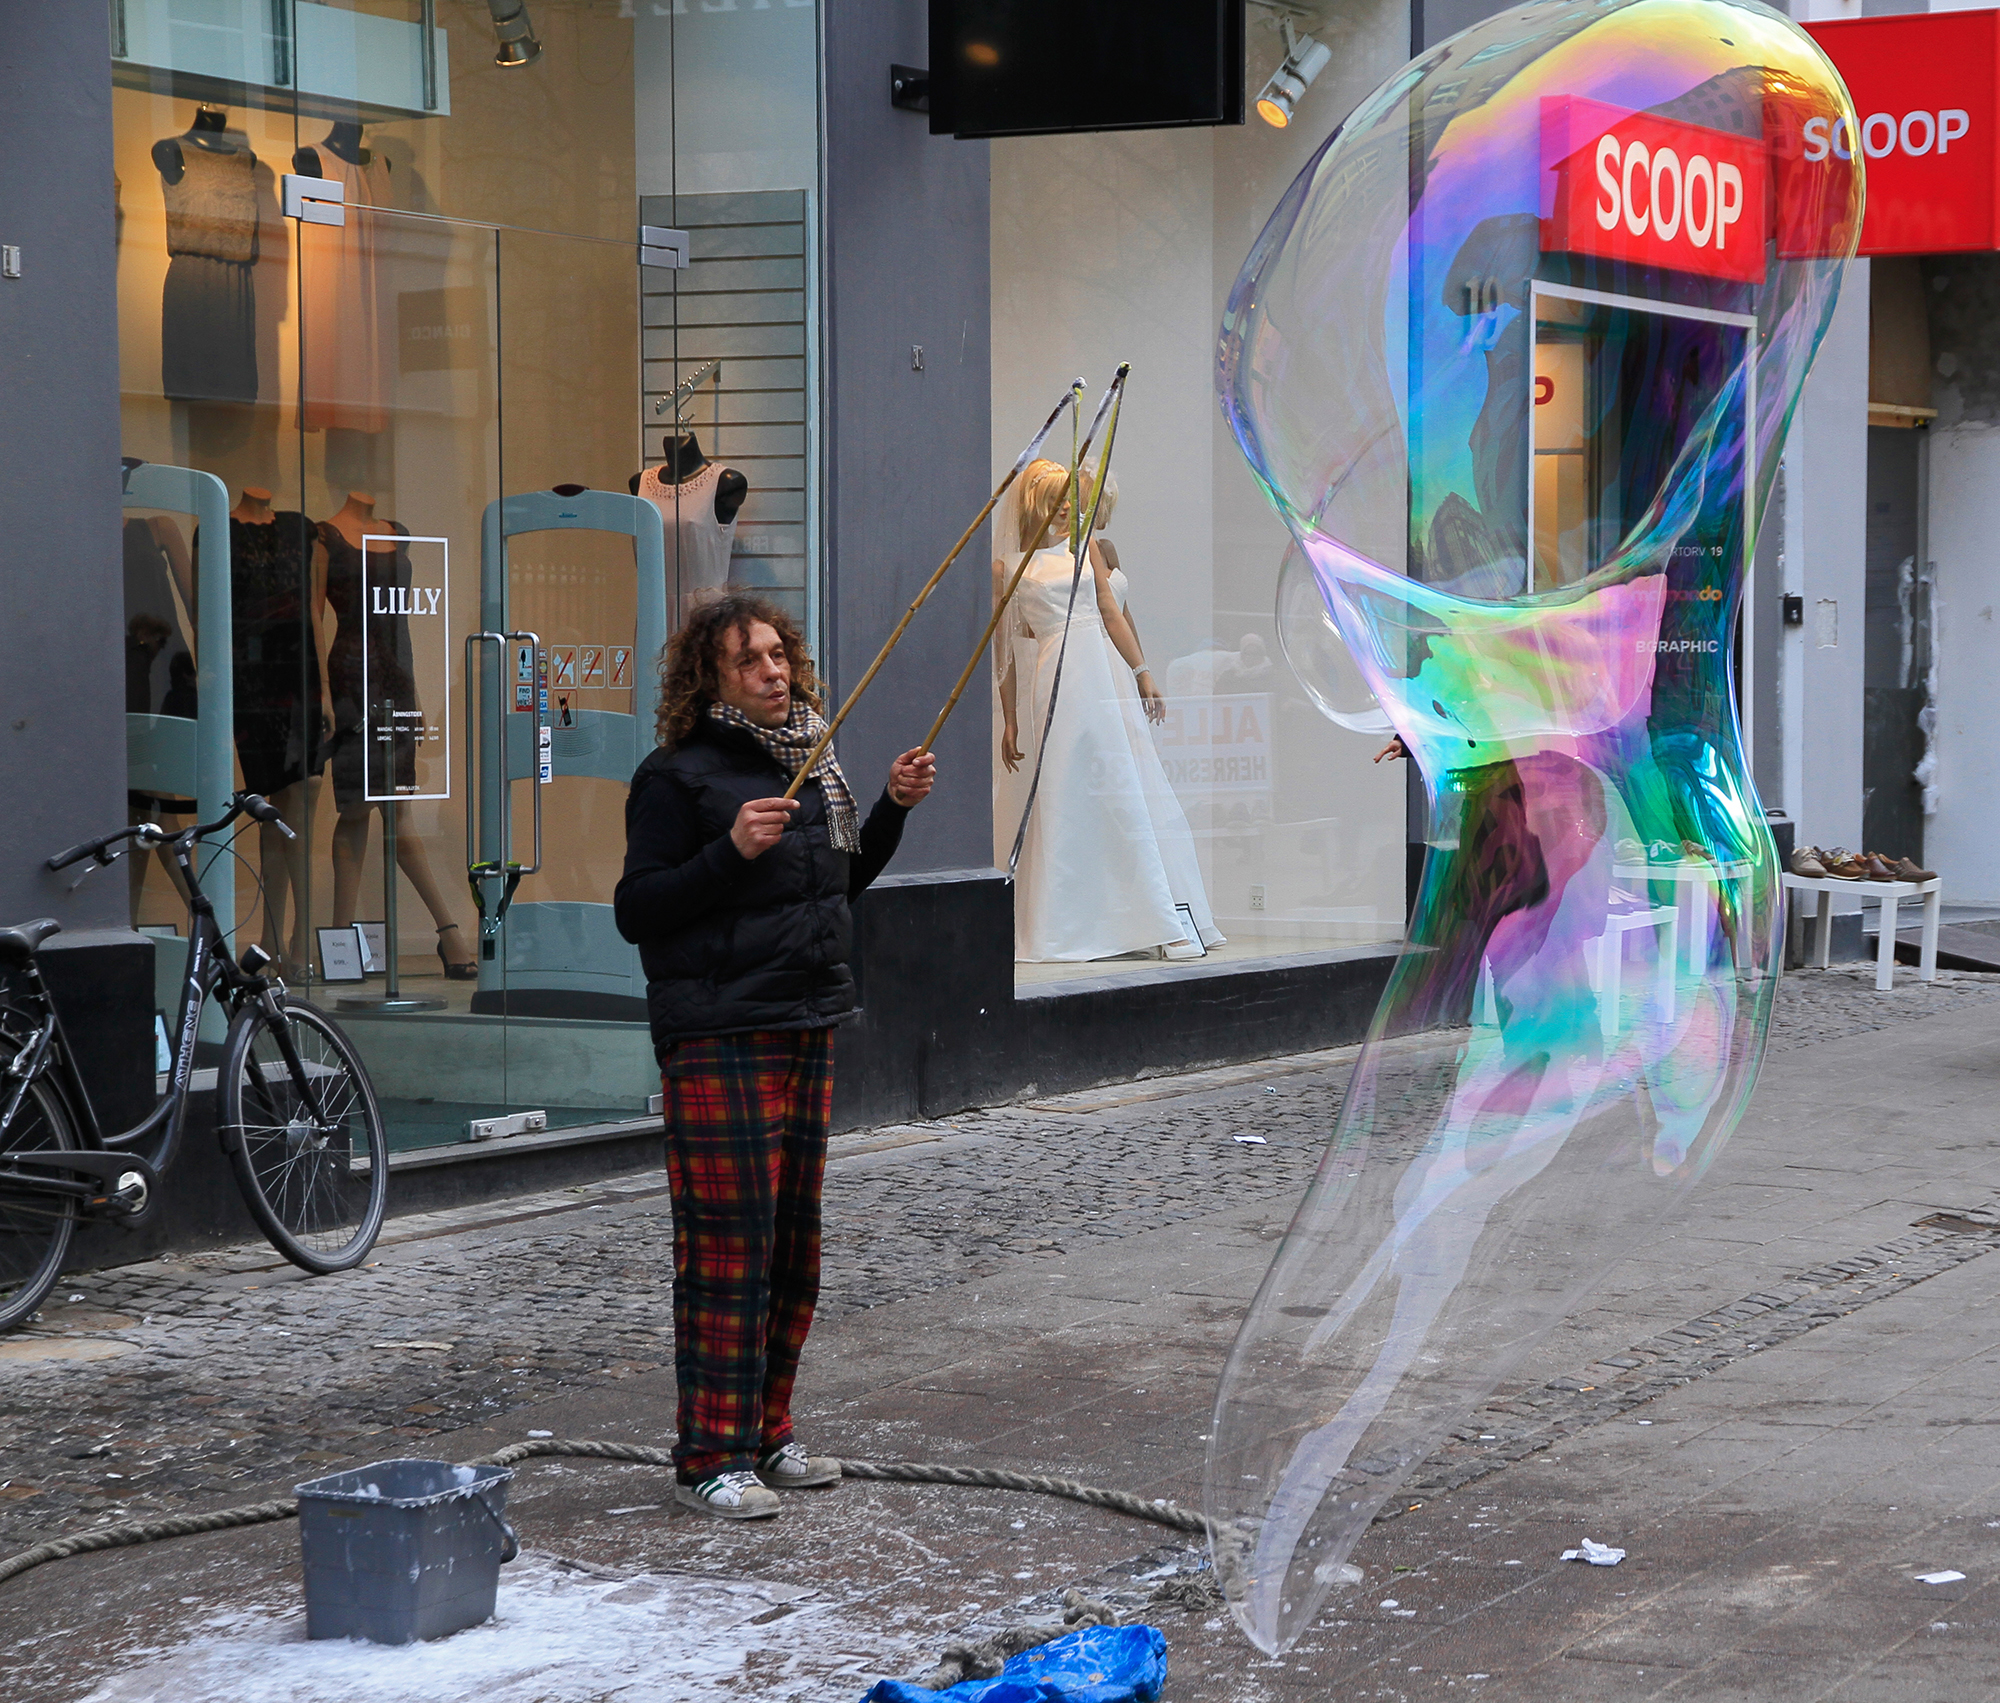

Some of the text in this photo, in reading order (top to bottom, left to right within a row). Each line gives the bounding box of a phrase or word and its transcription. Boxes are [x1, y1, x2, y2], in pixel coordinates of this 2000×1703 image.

[1803, 108, 1970, 162] SCOOP
[1595, 133, 1743, 250] SCOOP
[1710, 546, 1724, 557] 19
[373, 586, 442, 615] LILLY
[1636, 640, 1719, 653] BGRAPHIC
[174, 1000, 200, 1091] ATHENE
